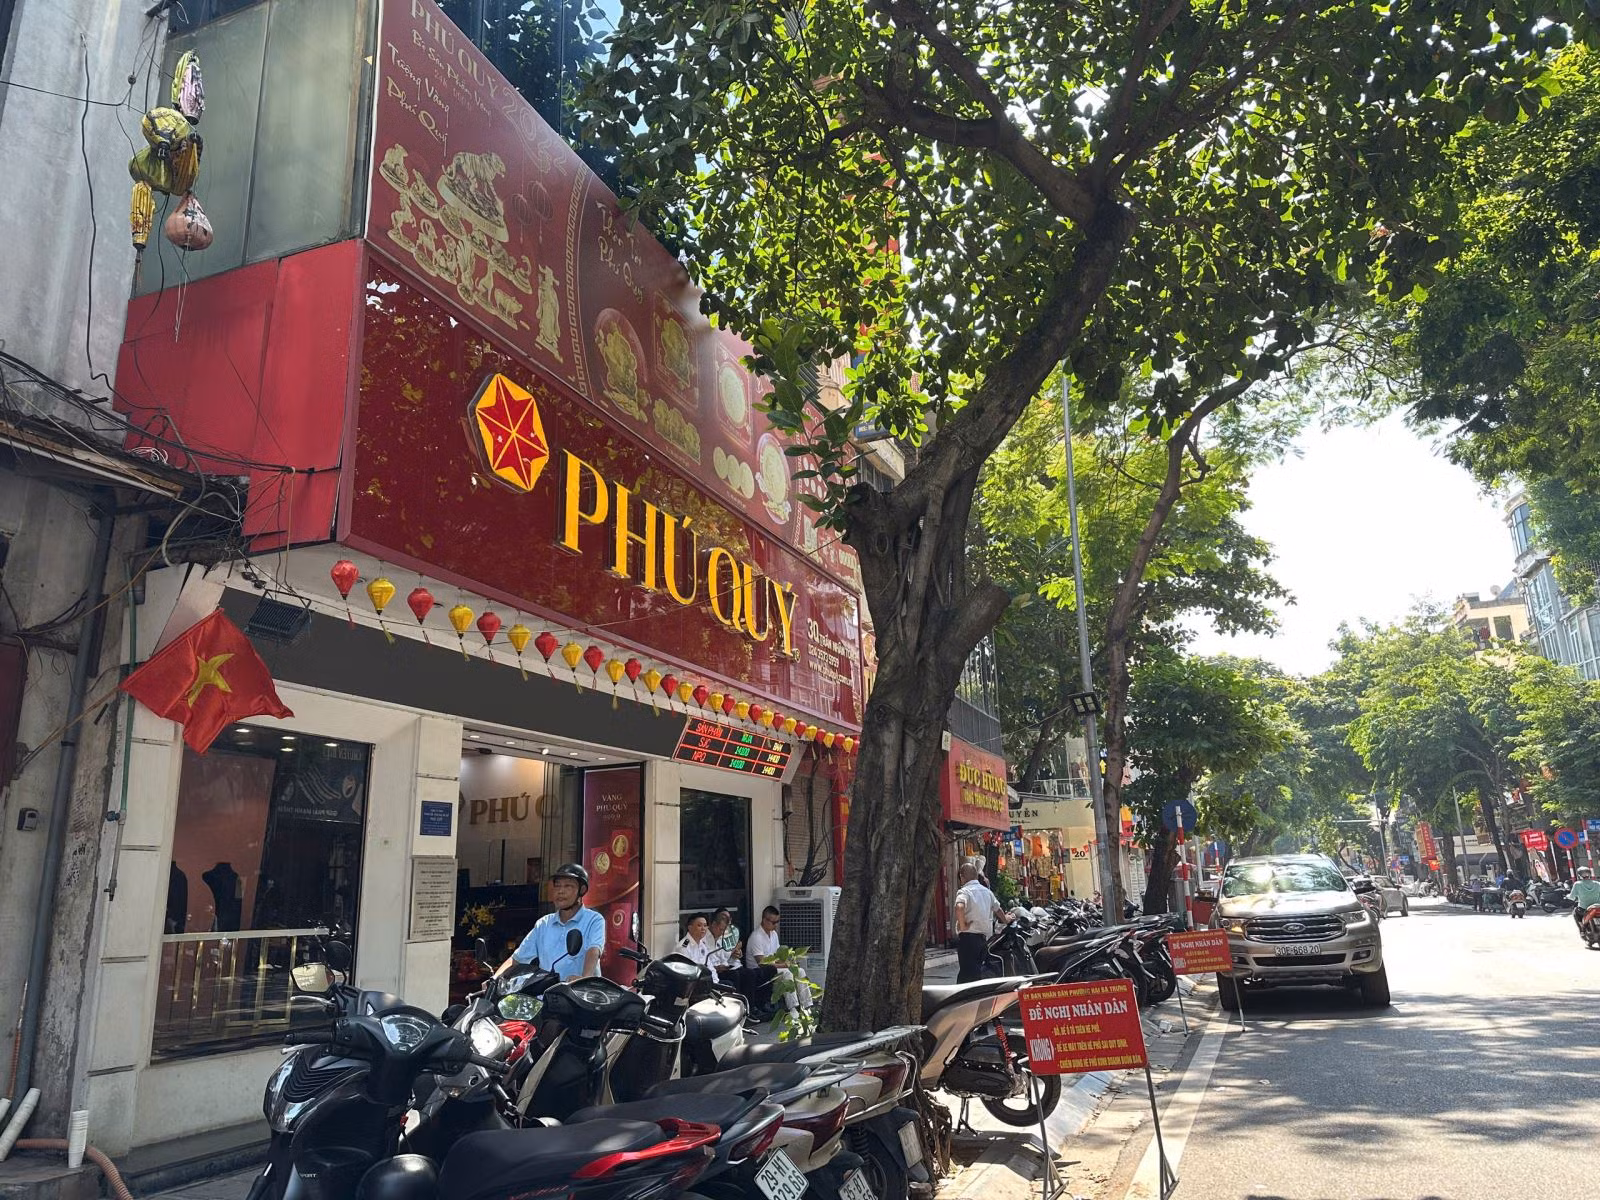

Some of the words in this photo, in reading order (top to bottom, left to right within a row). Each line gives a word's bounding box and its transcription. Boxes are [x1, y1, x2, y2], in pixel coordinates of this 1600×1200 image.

[410, 0, 455, 55] PHÚ
[458, 49, 498, 98] QUÝ
[559, 447, 700, 606] PHÚ
[706, 546, 799, 657] QUÝ
[807, 617, 820, 644] 30
[469, 791, 531, 825] PHÚ
[1074, 850, 1086, 858] 20
[1028, 1001, 1044, 1021] ĐỀ
[1044, 1004, 1071, 1021] NGHỊ
[1071, 1000, 1102, 1017] NHÂN
[1104, 997, 1128, 1014] DÂN
[1029, 1033, 1052, 1061] KHÔNG
[774, 1170, 805, 1200] 29.66
